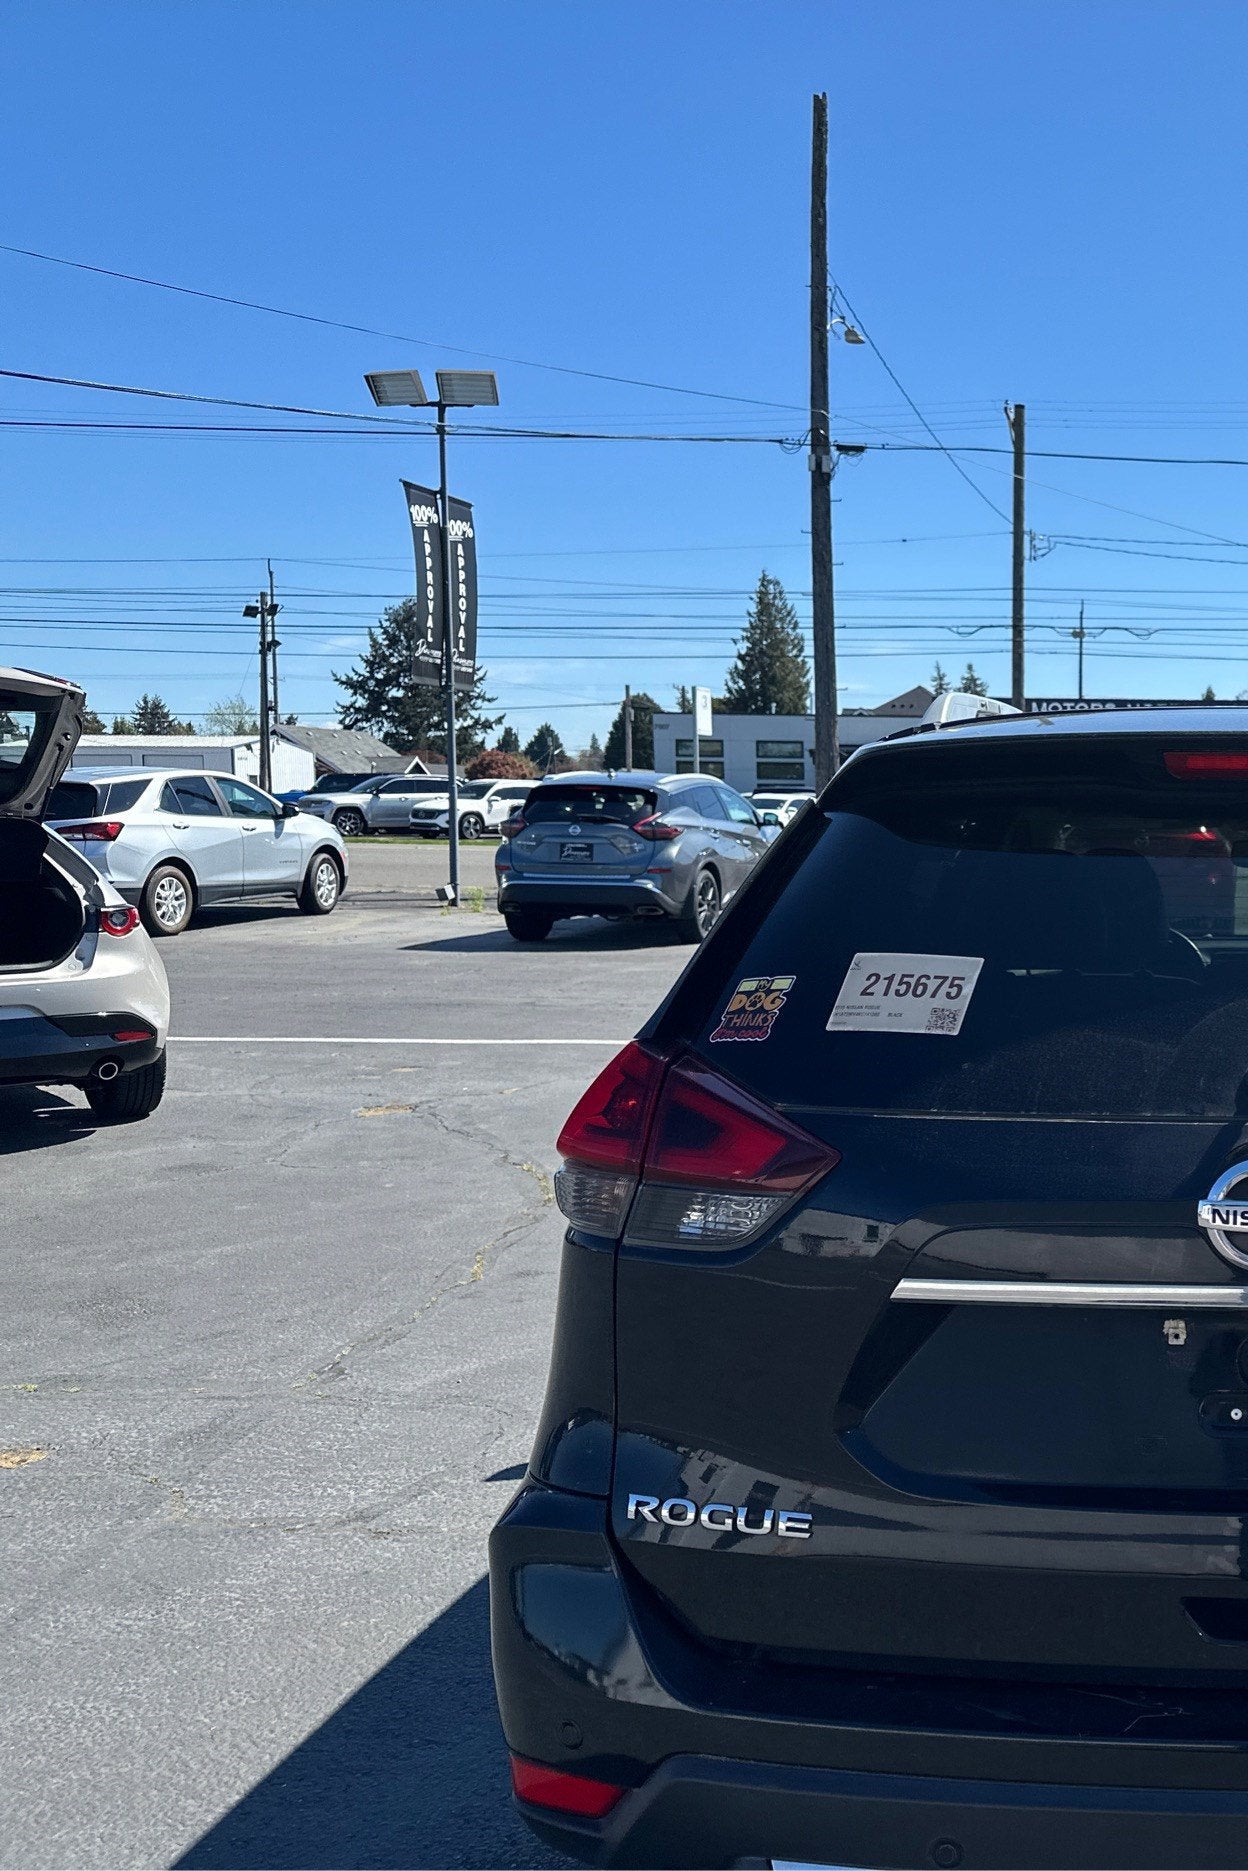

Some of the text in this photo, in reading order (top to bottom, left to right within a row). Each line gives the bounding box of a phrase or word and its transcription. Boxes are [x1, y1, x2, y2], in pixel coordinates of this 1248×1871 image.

[409, 504, 438, 524] 100%
[448, 519, 473, 538] 00%
[423, 528, 434, 643] APPROVAL
[457, 543, 467, 652] APPROVAL
[859, 972, 966, 1001] 215675
[727, 991, 783, 1012] DOG
[627, 1493, 813, 1539] ROGUE
